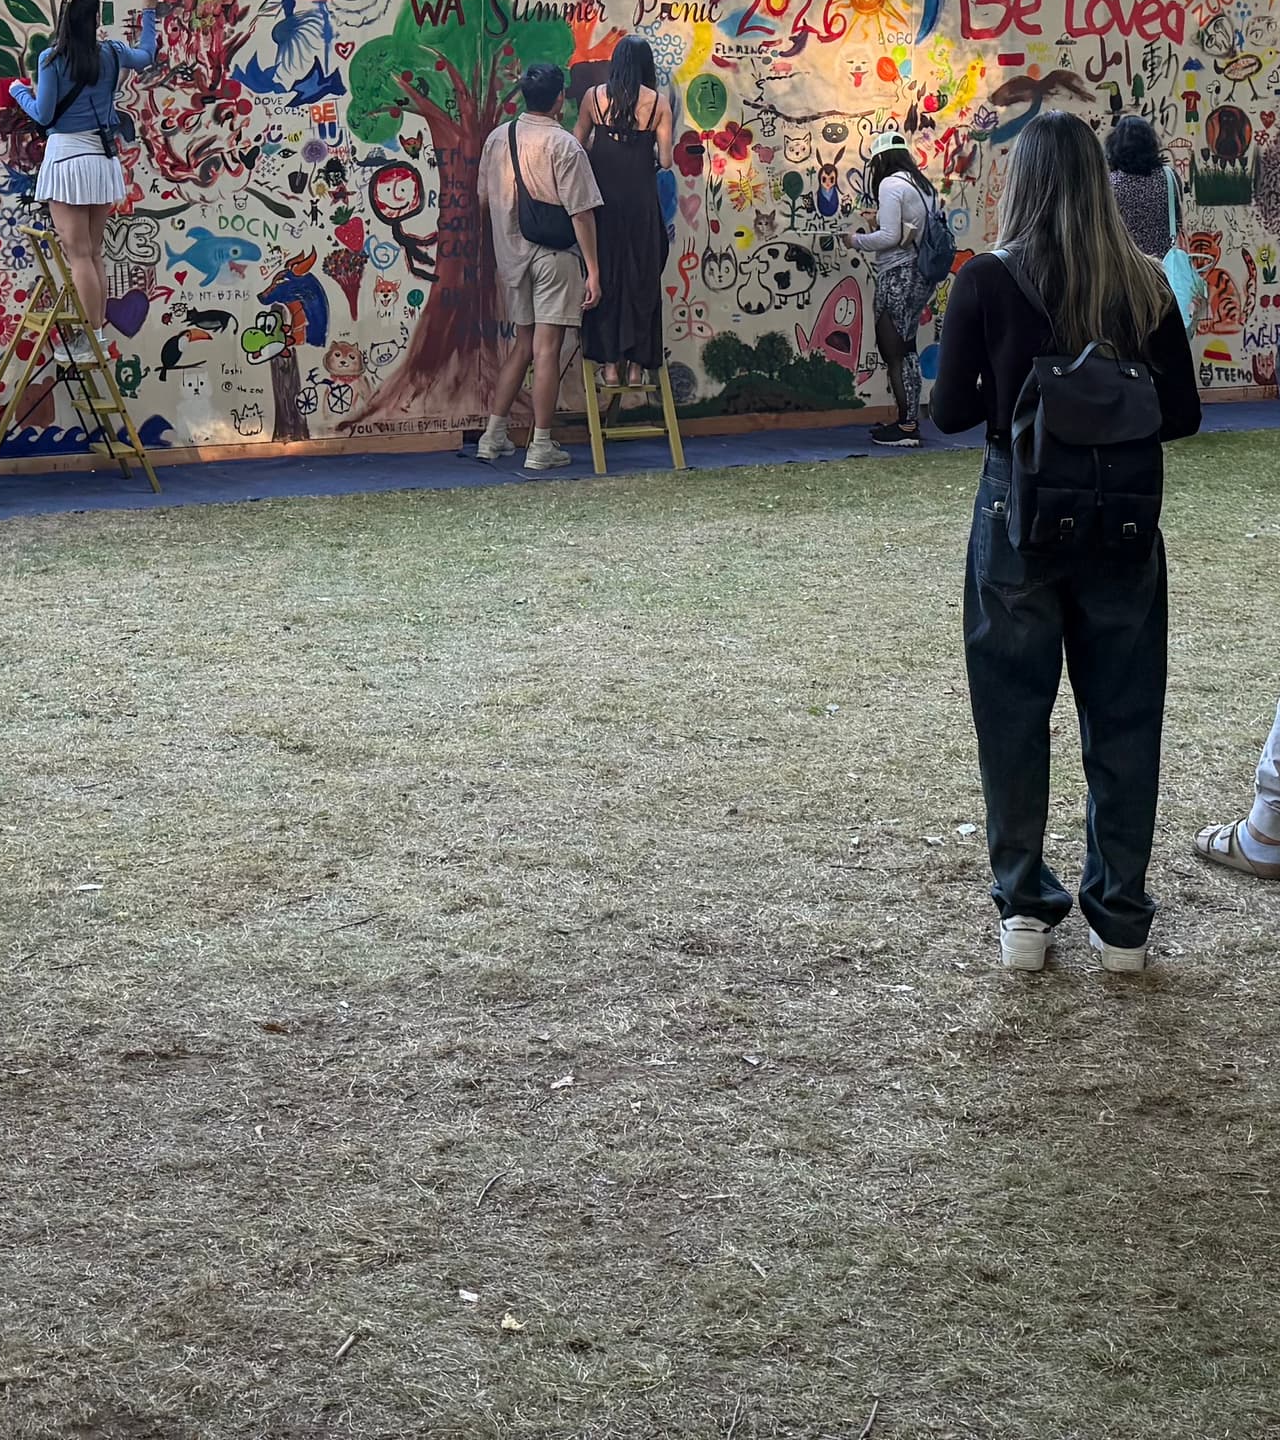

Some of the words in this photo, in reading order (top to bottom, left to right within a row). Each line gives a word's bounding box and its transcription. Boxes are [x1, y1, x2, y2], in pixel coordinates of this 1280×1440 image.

[310, 102, 338, 124] BE
[218, 214, 279, 242] DOCN
[1214, 366, 1253, 384] TEEMO
[349, 423, 373, 438] YOU
